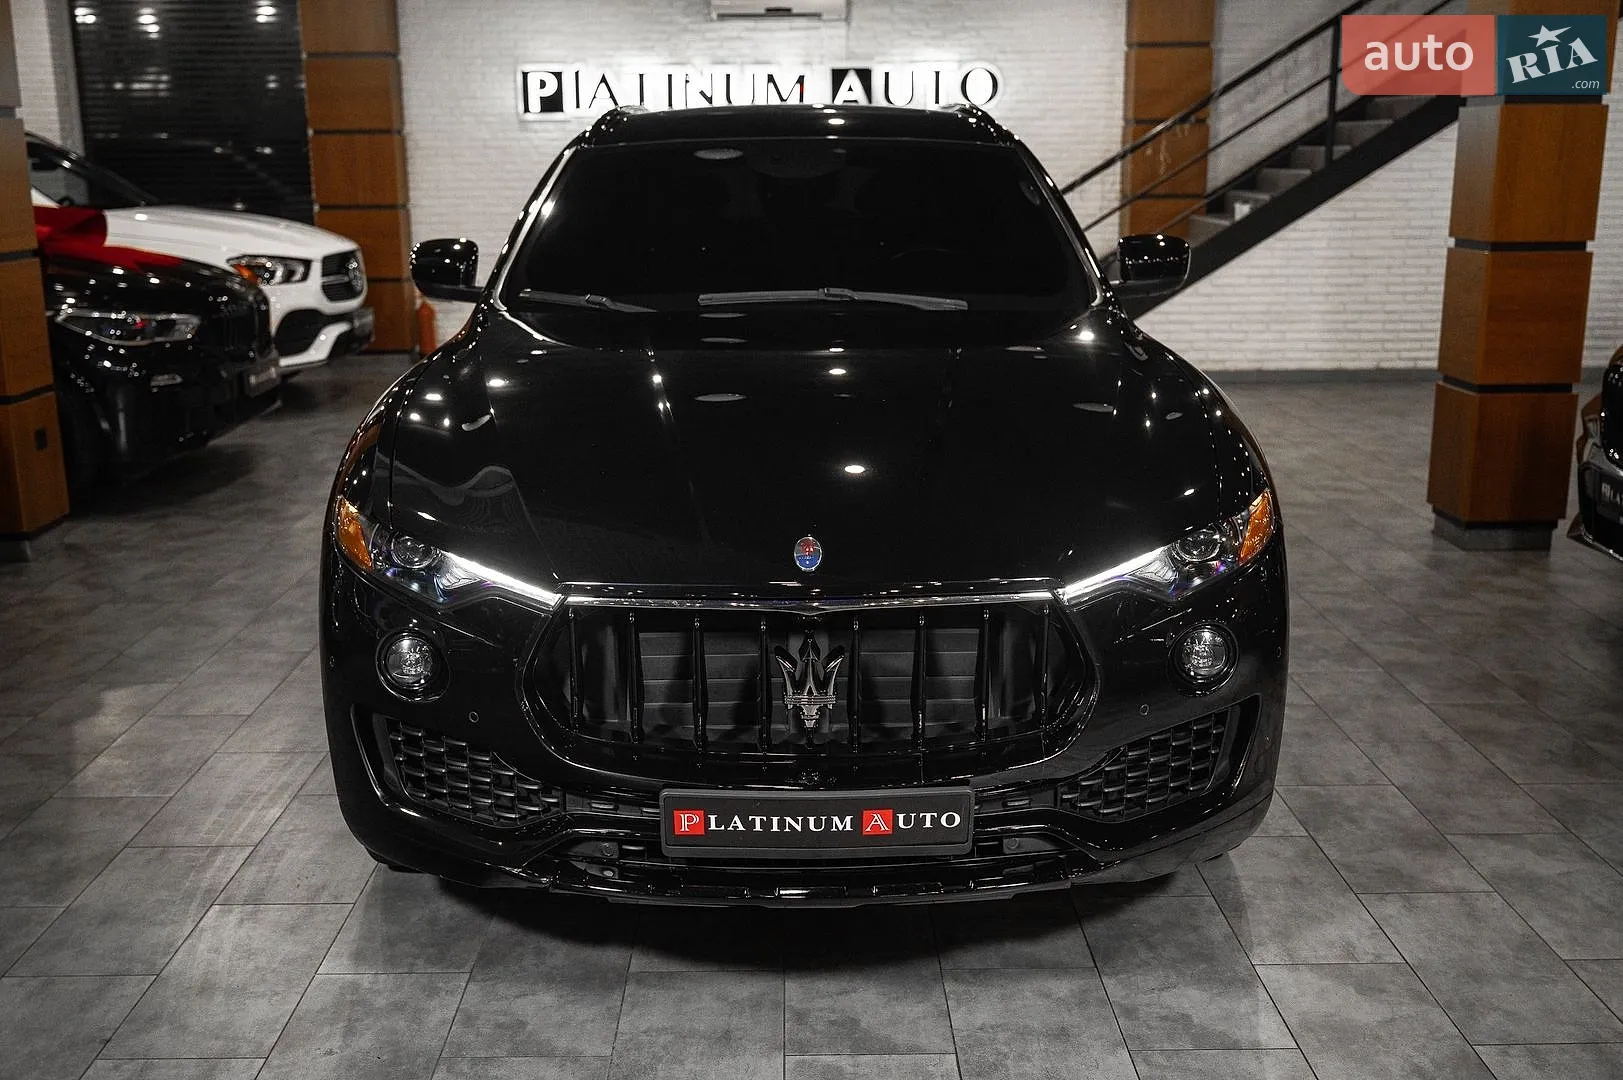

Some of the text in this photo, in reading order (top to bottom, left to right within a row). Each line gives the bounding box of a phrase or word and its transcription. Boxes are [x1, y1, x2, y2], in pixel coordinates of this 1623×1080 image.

[521, 67, 998, 112] PLATINUM AUTO
[675, 810, 961, 834] PLATINUM AUTO
